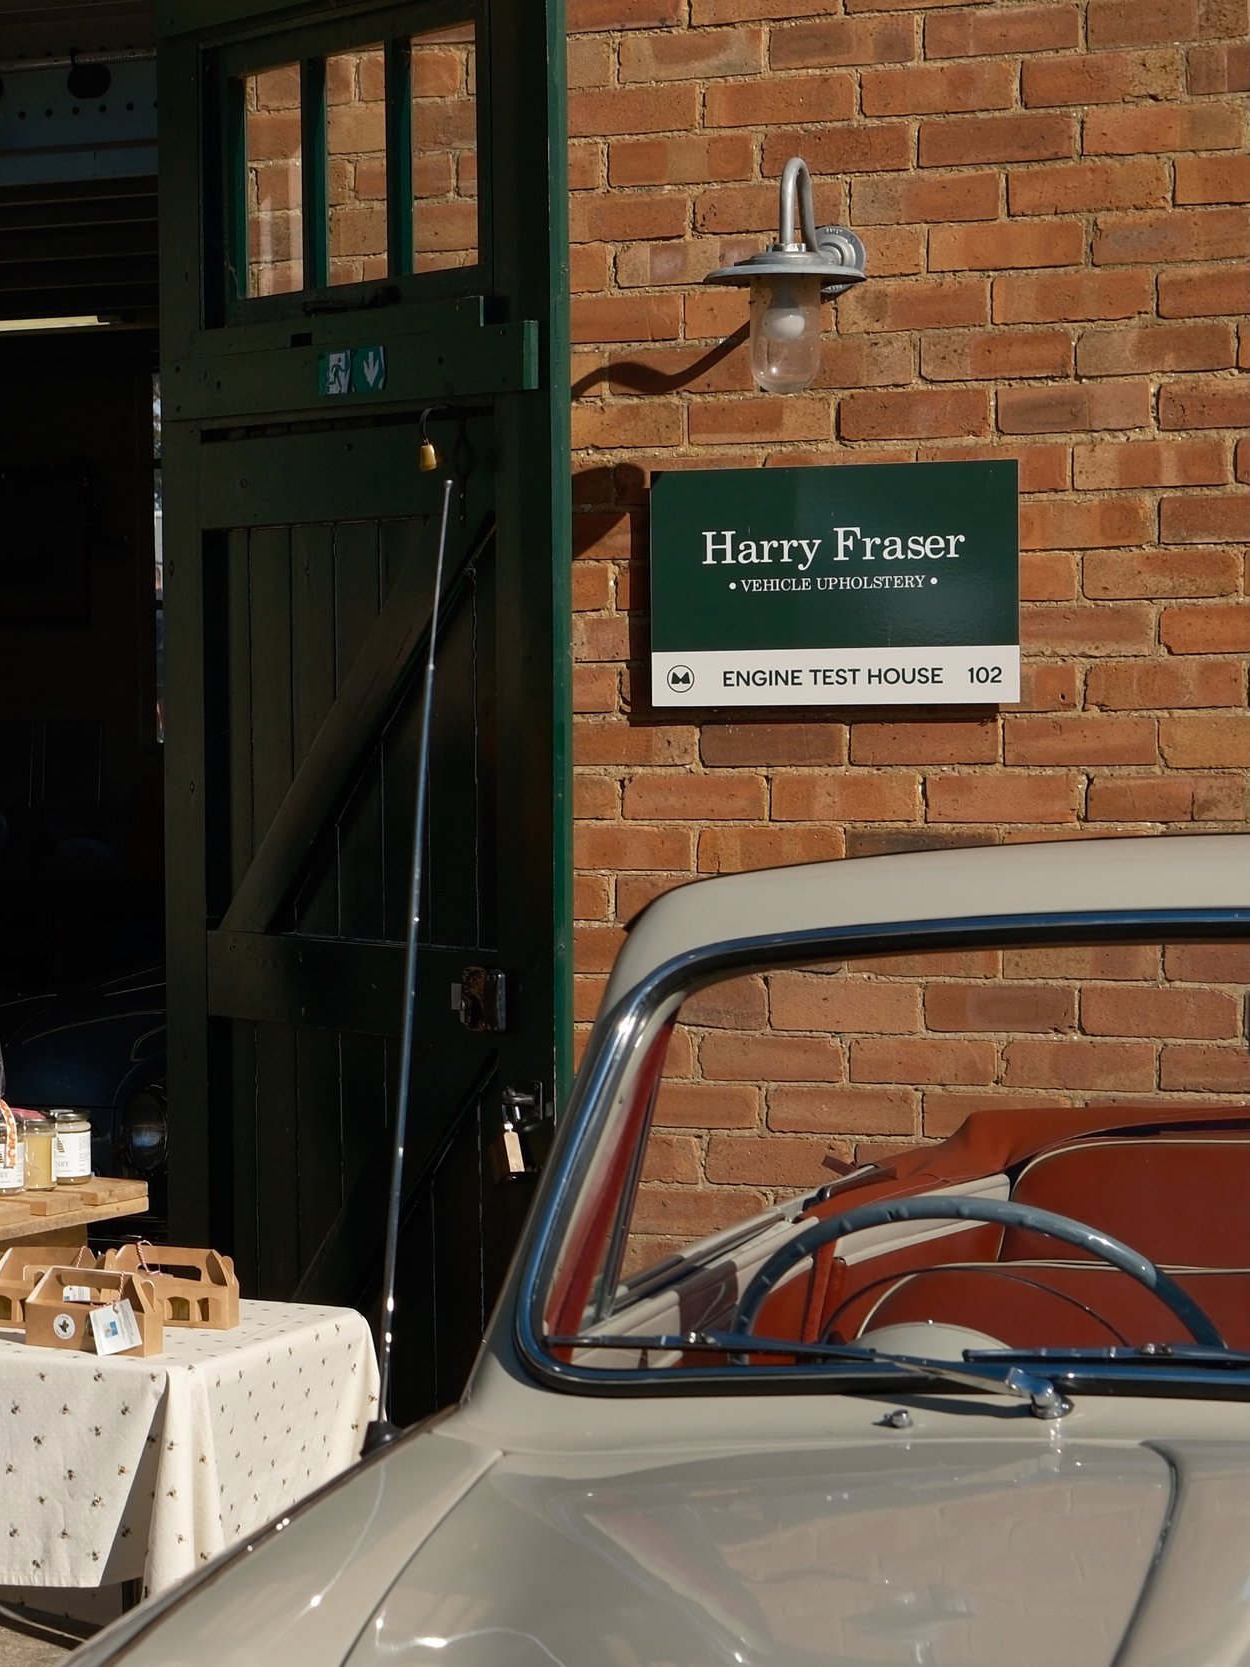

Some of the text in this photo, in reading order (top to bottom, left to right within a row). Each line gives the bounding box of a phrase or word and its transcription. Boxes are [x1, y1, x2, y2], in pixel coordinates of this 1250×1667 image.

[701, 526, 966, 571] Harry Fraser
[741, 575, 926, 592] VEHICLE UPHOLSTERY
[722, 666, 1002, 687] ENGINE TEST HOUSE 102
